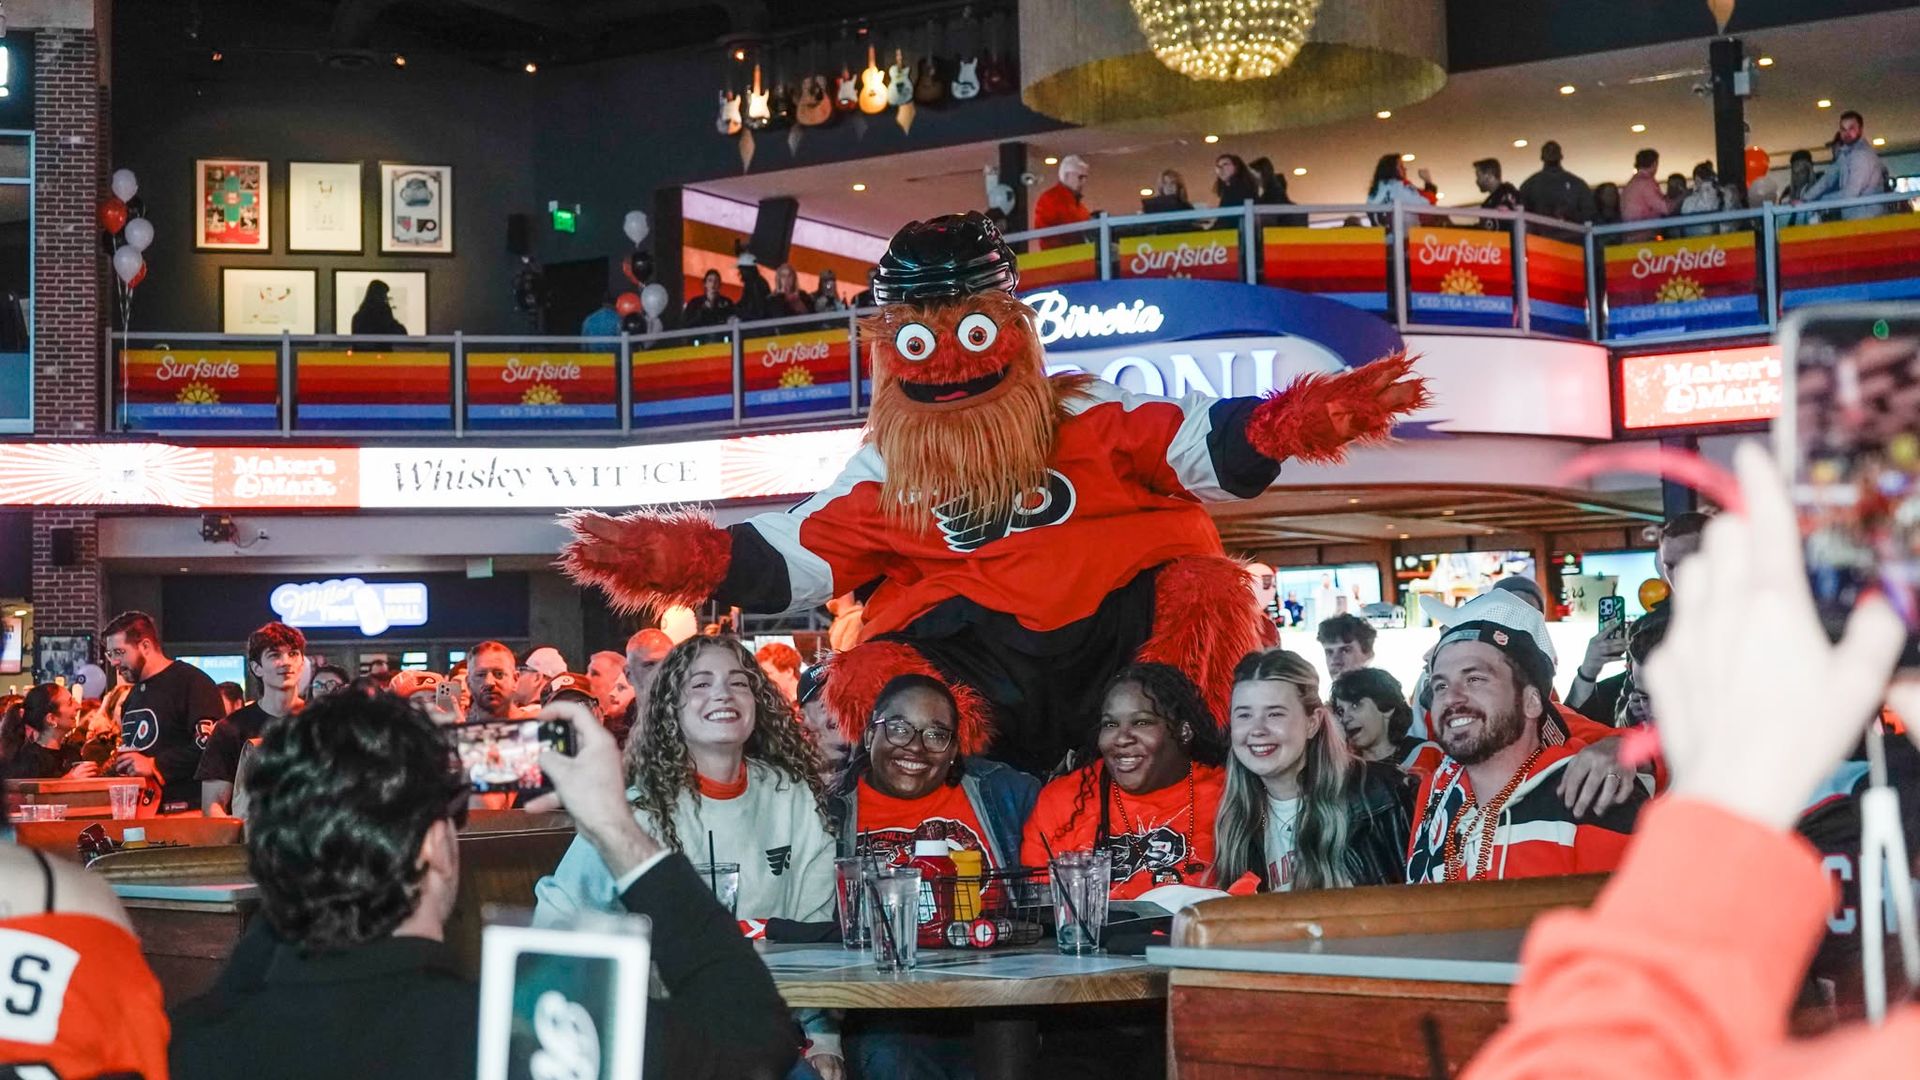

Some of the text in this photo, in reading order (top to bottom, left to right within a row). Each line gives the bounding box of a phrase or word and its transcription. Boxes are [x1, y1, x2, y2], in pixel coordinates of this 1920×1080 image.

[1130, 241, 1228, 274] Surfside
[1419, 233, 1502, 266] Surfside
[1632, 244, 1726, 279] Surfside
[1021, 289, 1164, 344] Birreria
[1445, 298, 1462, 309] TEA
[1474, 300, 1506, 311] VODKA
[156, 355, 240, 381] Surfside
[762, 339, 829, 368] Surfside
[502, 358, 581, 383] Surfside
[1663, 356, 1781, 387] Maker's
[1696, 380, 1782, 409] Mark
[153, 406, 176, 415] ICED
[179, 406, 198, 415] TEA
[210, 406, 243, 415] VODKA
[233, 456, 336, 475] Maker's
[394, 456, 532, 498] Whisky
[545, 465, 628, 487] WIT
[259, 476, 337, 496] Mark
